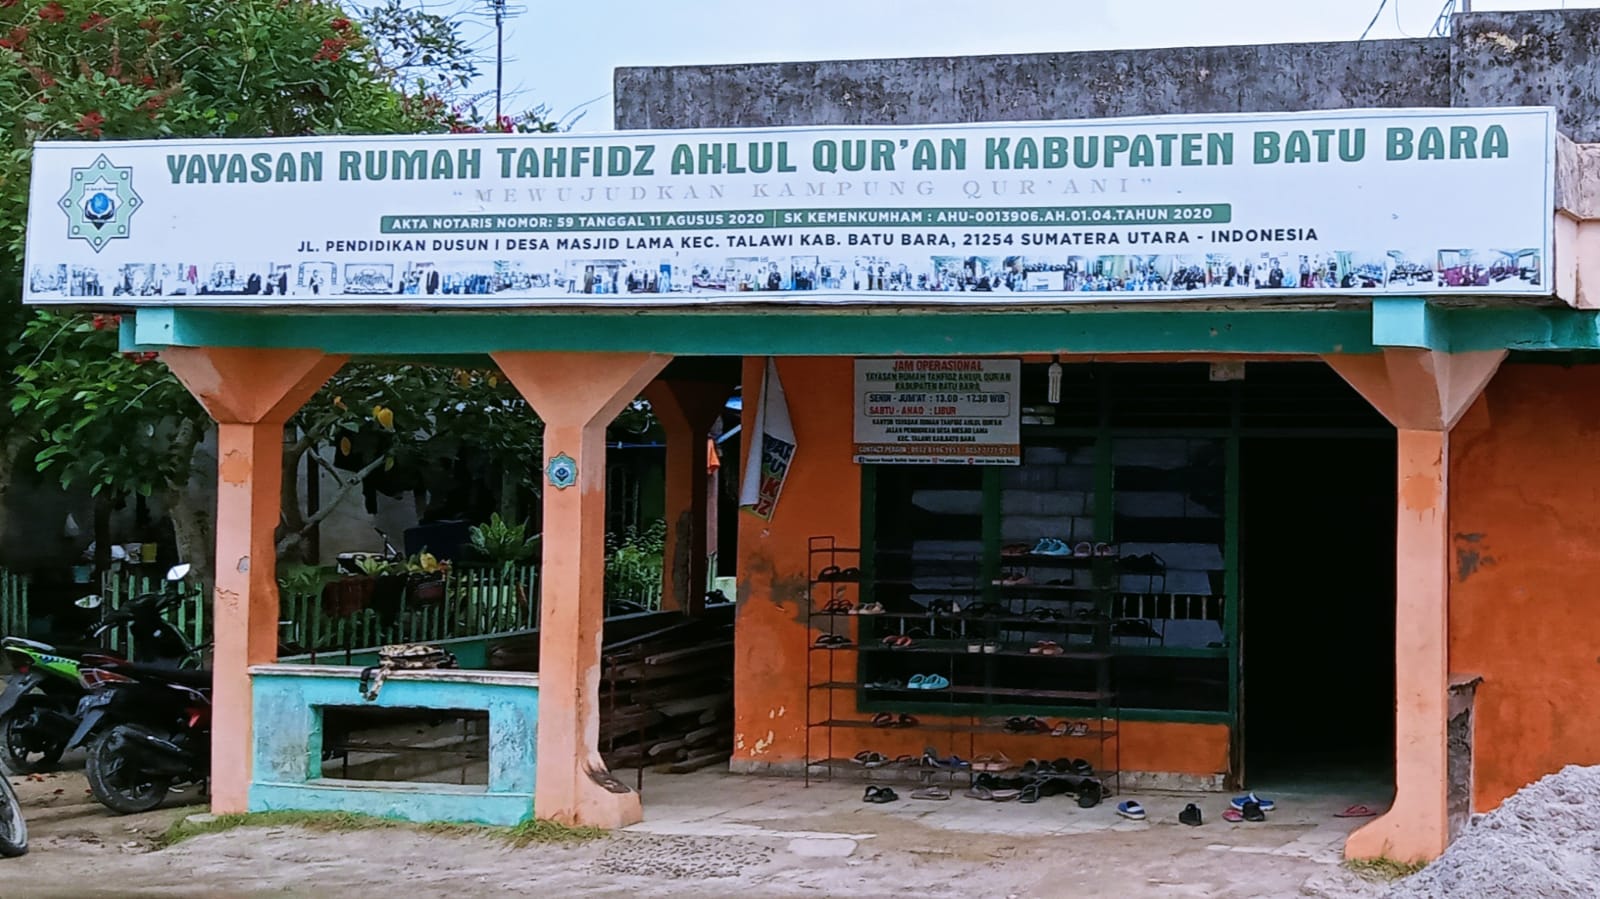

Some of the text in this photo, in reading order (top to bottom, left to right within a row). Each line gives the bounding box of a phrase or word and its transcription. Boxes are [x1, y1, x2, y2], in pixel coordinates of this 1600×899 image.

[167, 125, 1508, 184] YAYASAN RUMAH TAHFIDZ AHLUL QUR'AN KABUPATEN BATU BARA
[752, 180, 934, 197] KAMPUNG
[392, 219, 428, 229] AKTA
[433, 218, 492, 228] NOTARIS
[497, 218, 552, 228] NOMOR:
[557, 217, 573, 227] 59
[578, 216, 645, 227] TANGGAL
[650, 216, 661, 226] 11
[666, 214, 723, 225] AGUSUS
[729, 214, 764, 224] 2020
[784, 213, 802, 223] SK
[808, 212, 922, 222] KEMENKUMHAM
[1173, 208, 1212, 219] 2020
[298, 241, 319, 252] JL.
[326, 240, 425, 252] PENDIDIKAN
[433, 239, 488, 251] DUSUN
[495, 239, 499, 250] I
[506, 239, 549, 250] DESA
[557, 238, 619, 250] MASJID
[627, 237, 674, 249] LAMA
[681, 236, 719, 248] KEC.
[727, 235, 792, 247] TALAWI
[800, 234, 840, 246] KAB.
[848, 234, 893, 245] BATU
[901, 234, 955, 247] BARA,
[963, 233, 1013, 245] 21254
[1021, 232, 1120, 245] SUMATERA
[1128, 231, 1189, 244] UTARA
[1212, 228, 1318, 242] INDONESIA
[893, 360, 983, 371] JAM OPERASIONAL
[870, 406, 894, 414] SABTU
[934, 406, 956, 414] LIBUR
